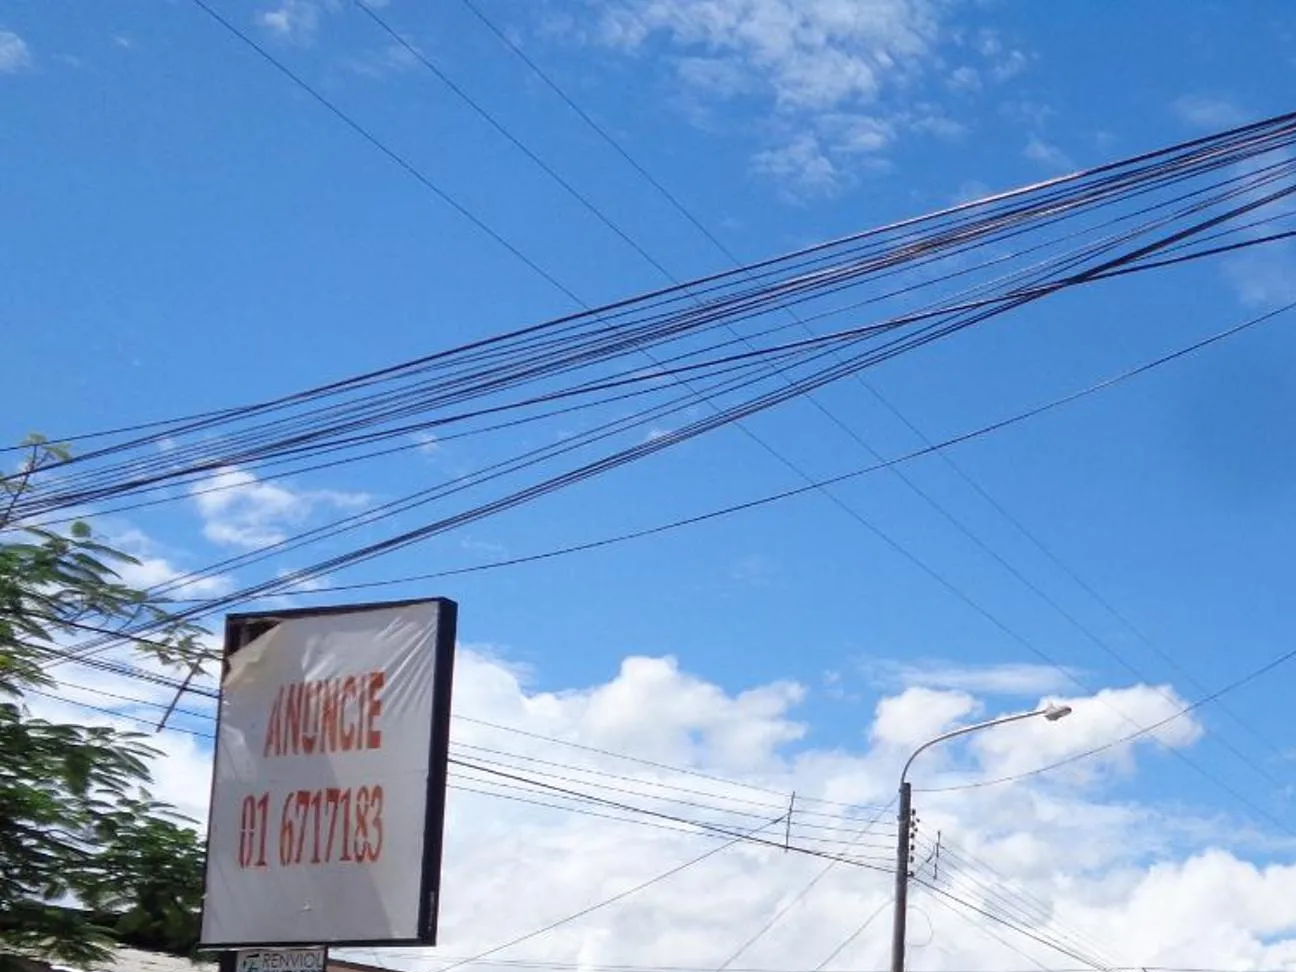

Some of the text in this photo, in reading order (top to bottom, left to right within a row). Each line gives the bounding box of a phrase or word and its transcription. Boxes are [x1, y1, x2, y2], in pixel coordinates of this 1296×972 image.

[264, 671, 385, 757] ANUNCIE
[239, 785, 384, 868] 01 6717183
